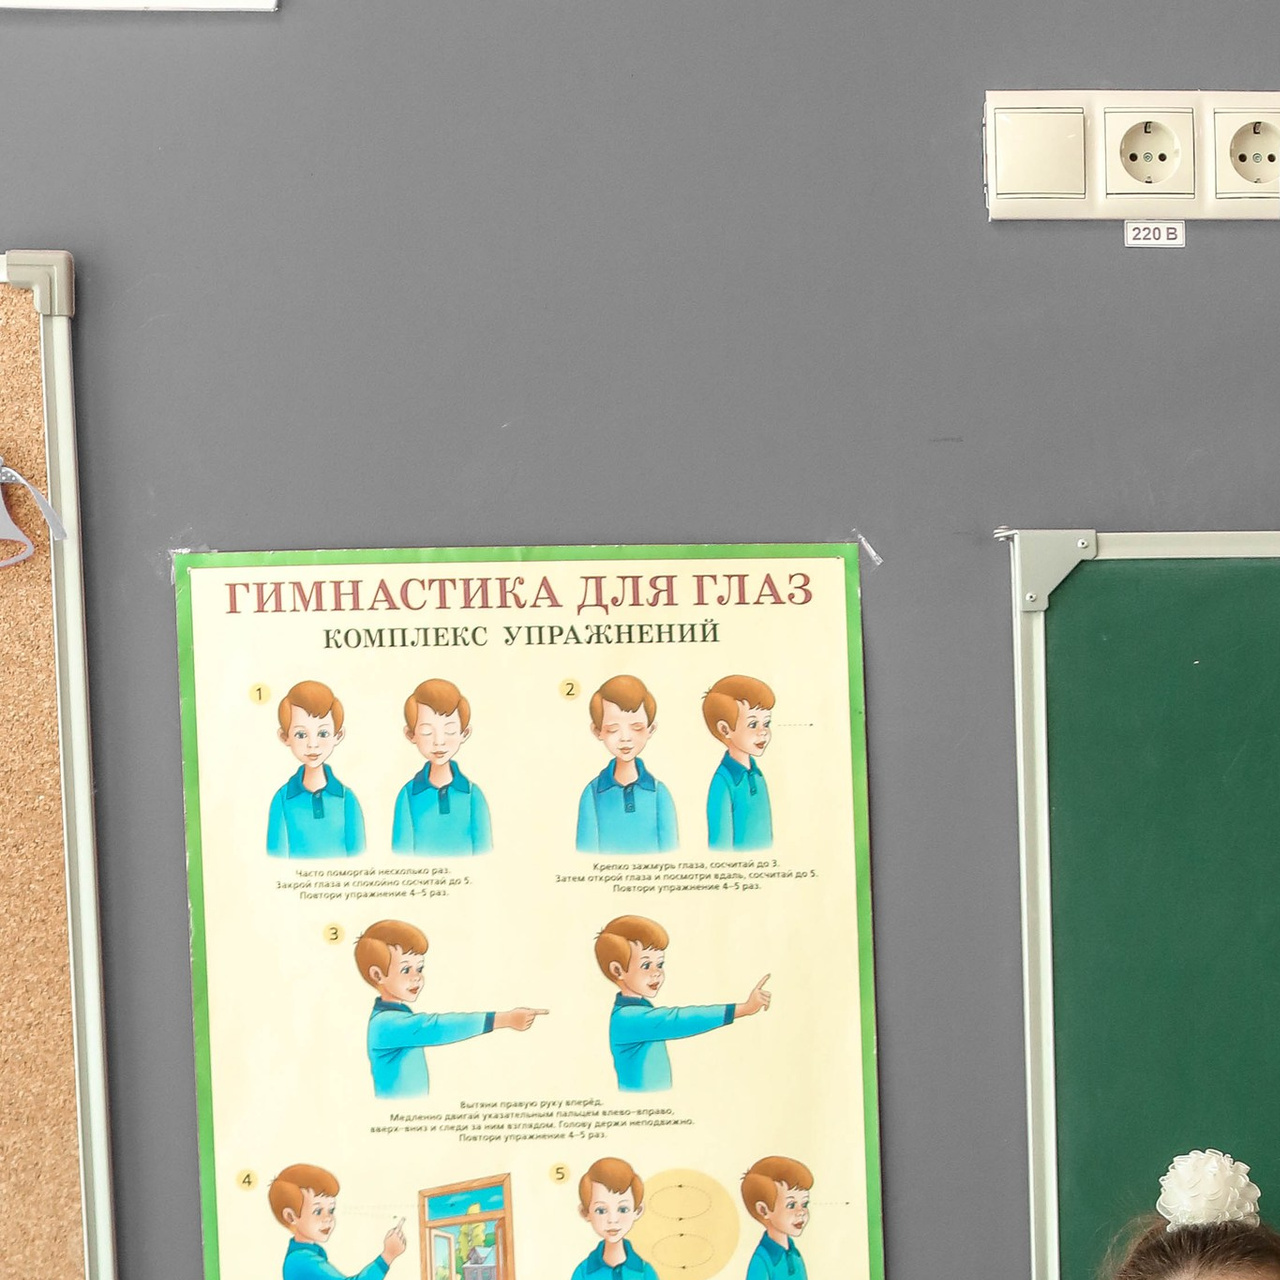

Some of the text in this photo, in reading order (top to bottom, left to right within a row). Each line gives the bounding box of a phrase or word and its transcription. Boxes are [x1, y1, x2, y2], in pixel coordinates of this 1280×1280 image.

[1132, 226, 1178, 241] 220 В
[224, 572, 813, 616] ГИМНАСТИКА ДЛЯ ГЛАЗ
[323, 619, 719, 650] КОМПЛЕКС УПРАЖНЕНИЙ
[256, 687, 262, 700] 1
[565, 682, 575, 696] 2
[593, 862, 629, 872] Крепко
[632, 862, 676, 871] зажмурь
[678, 862, 707, 870] глаза,
[709, 859, 754, 868] сосчитай
[555, 873, 585, 882] Затем
[587, 873, 623, 883] открой
[663, 873, 711, 882] посмотри
[713, 872, 746, 881] вдаль,
[748, 870, 793, 878] сосчитай
[613, 883, 655, 893] Повтори
[657, 884, 720, 893] упражнение
[742, 883, 763, 891] раз.
[330, 927, 339, 941] 3
[242, 1173, 252, 1186] 4
[555, 1166, 565, 1180] 5
